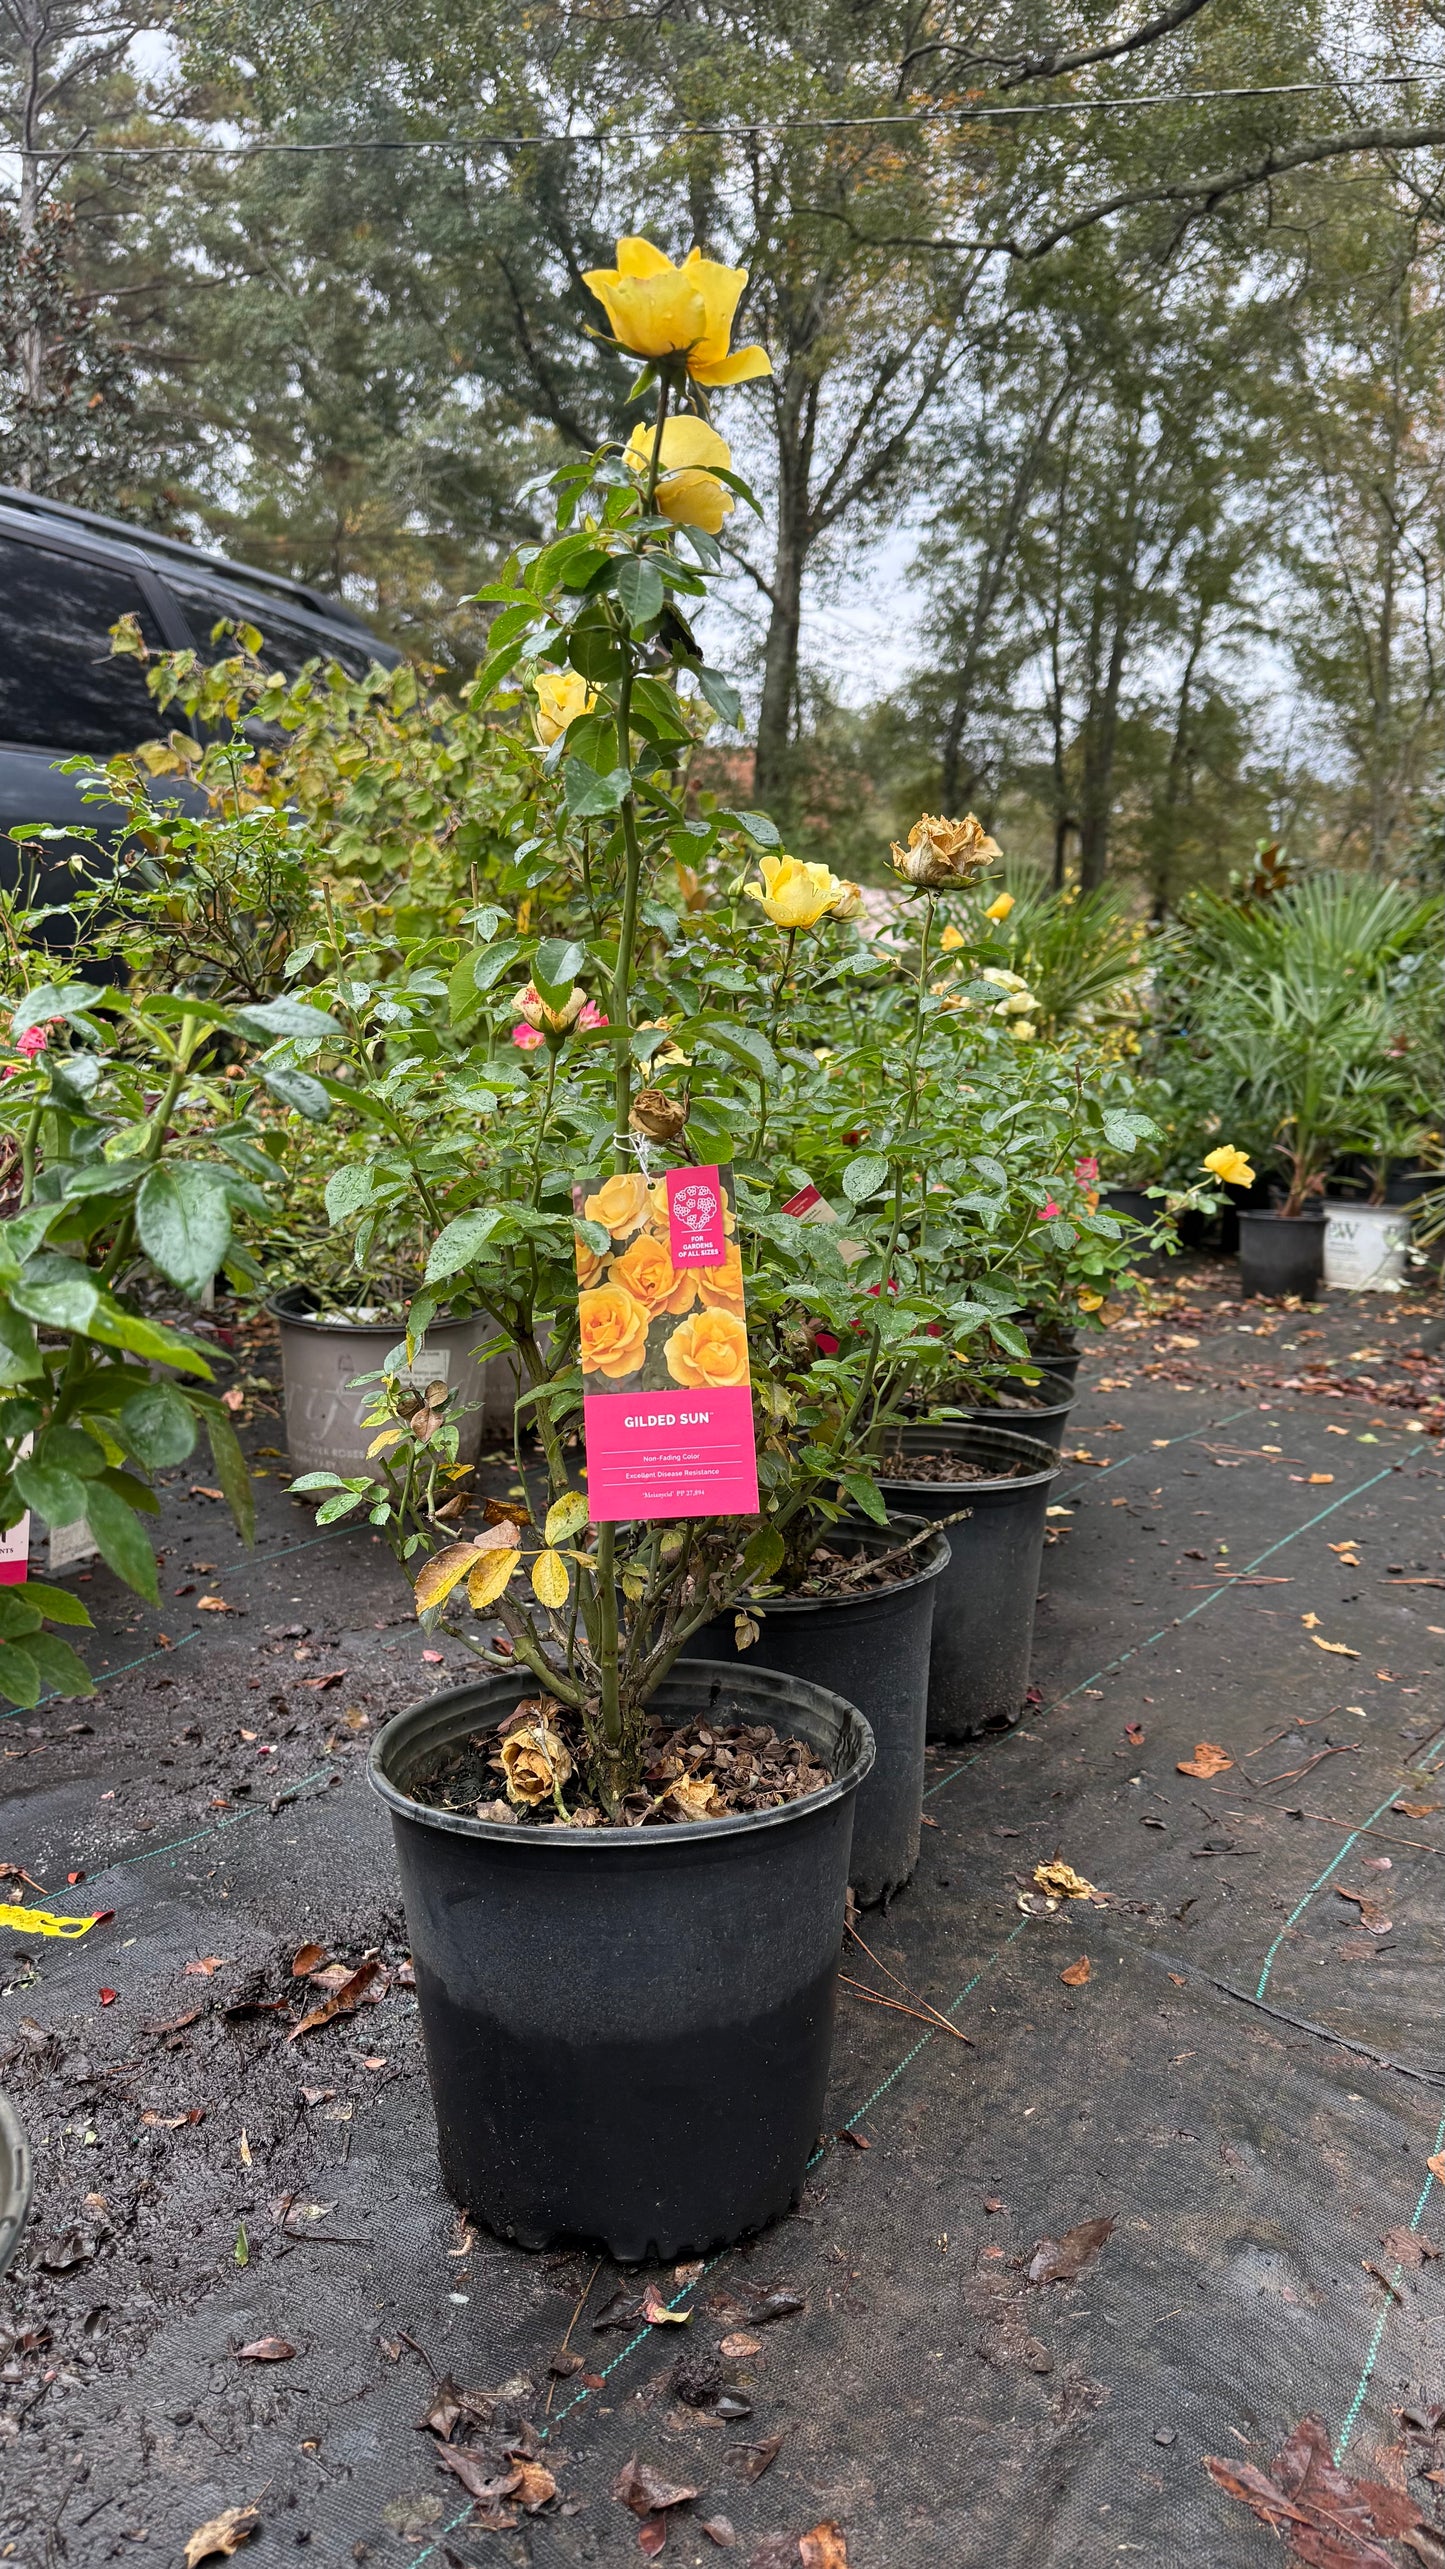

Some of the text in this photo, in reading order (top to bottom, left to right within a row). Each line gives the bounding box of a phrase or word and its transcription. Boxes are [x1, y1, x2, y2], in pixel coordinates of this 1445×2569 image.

[683, 1242, 713, 1250] GARDENS
[624, 1414, 676, 1428] GILDED
[643, 1454, 681, 1462] Non-Fading
[625, 1468, 720, 1479] Excellent Disease Resistance
